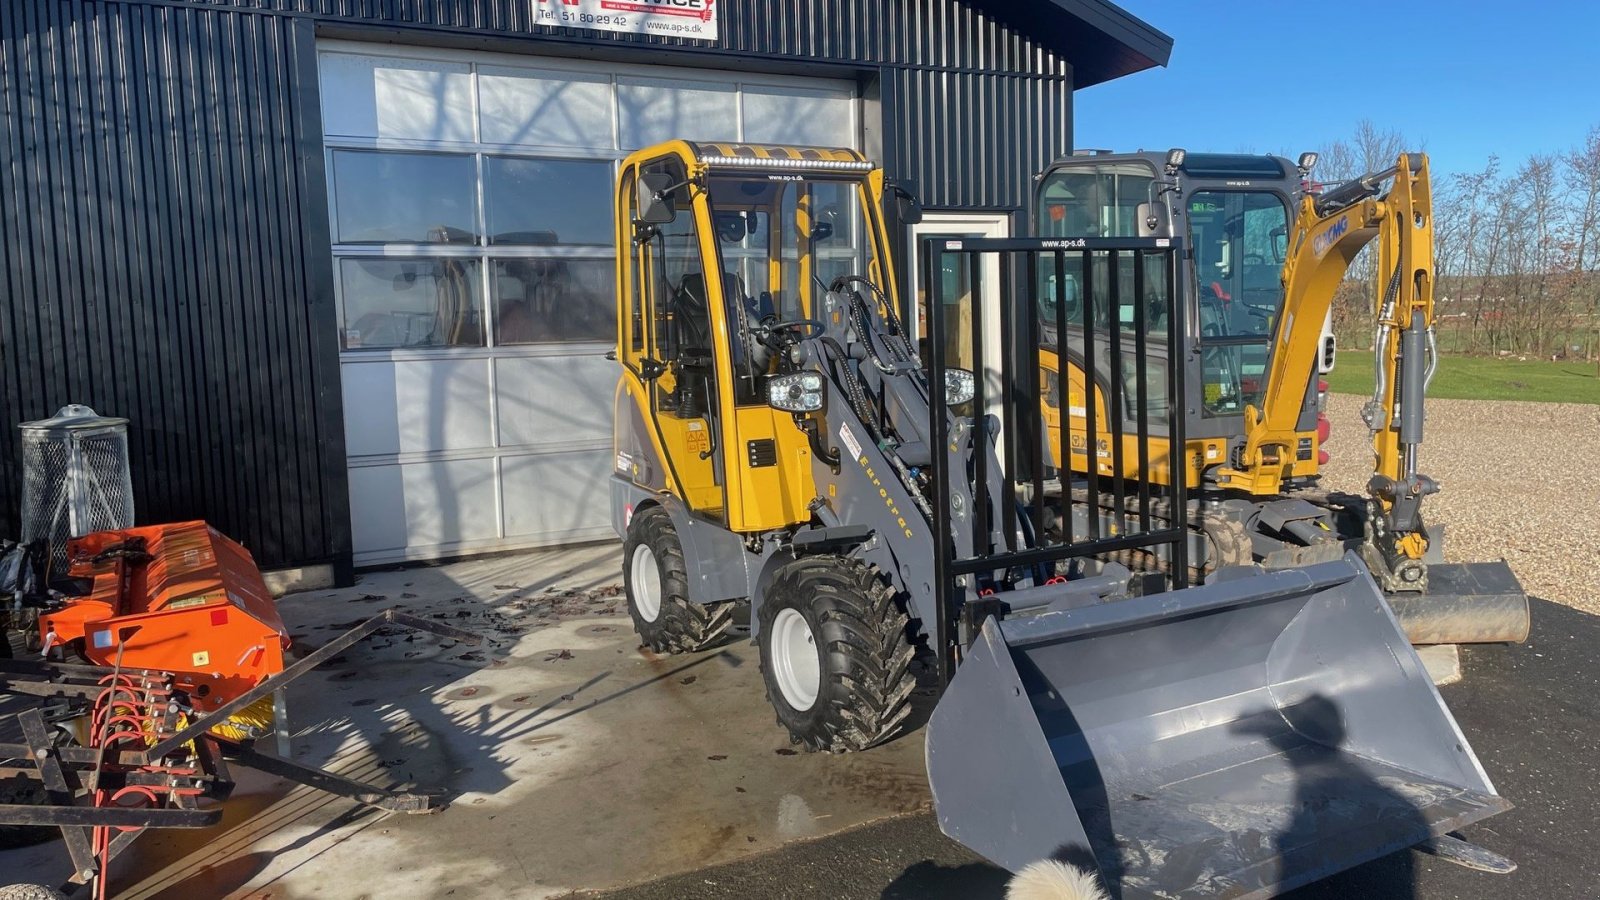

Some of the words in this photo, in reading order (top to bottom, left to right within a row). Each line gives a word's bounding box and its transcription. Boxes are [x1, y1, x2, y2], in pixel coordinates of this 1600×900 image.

[539, 9, 556, 20] Tel.
[562, 12, 575, 21] 51
[579, 13, 594, 23] 80
[596, 15, 610, 24] 29
[613, 16, 627, 26] 42
[646, 21, 702, 33] www.ap-s.dk
[1041, 238, 1086, 249] www.ap-s.dk
[859, 455, 913, 539] Eurotrac
